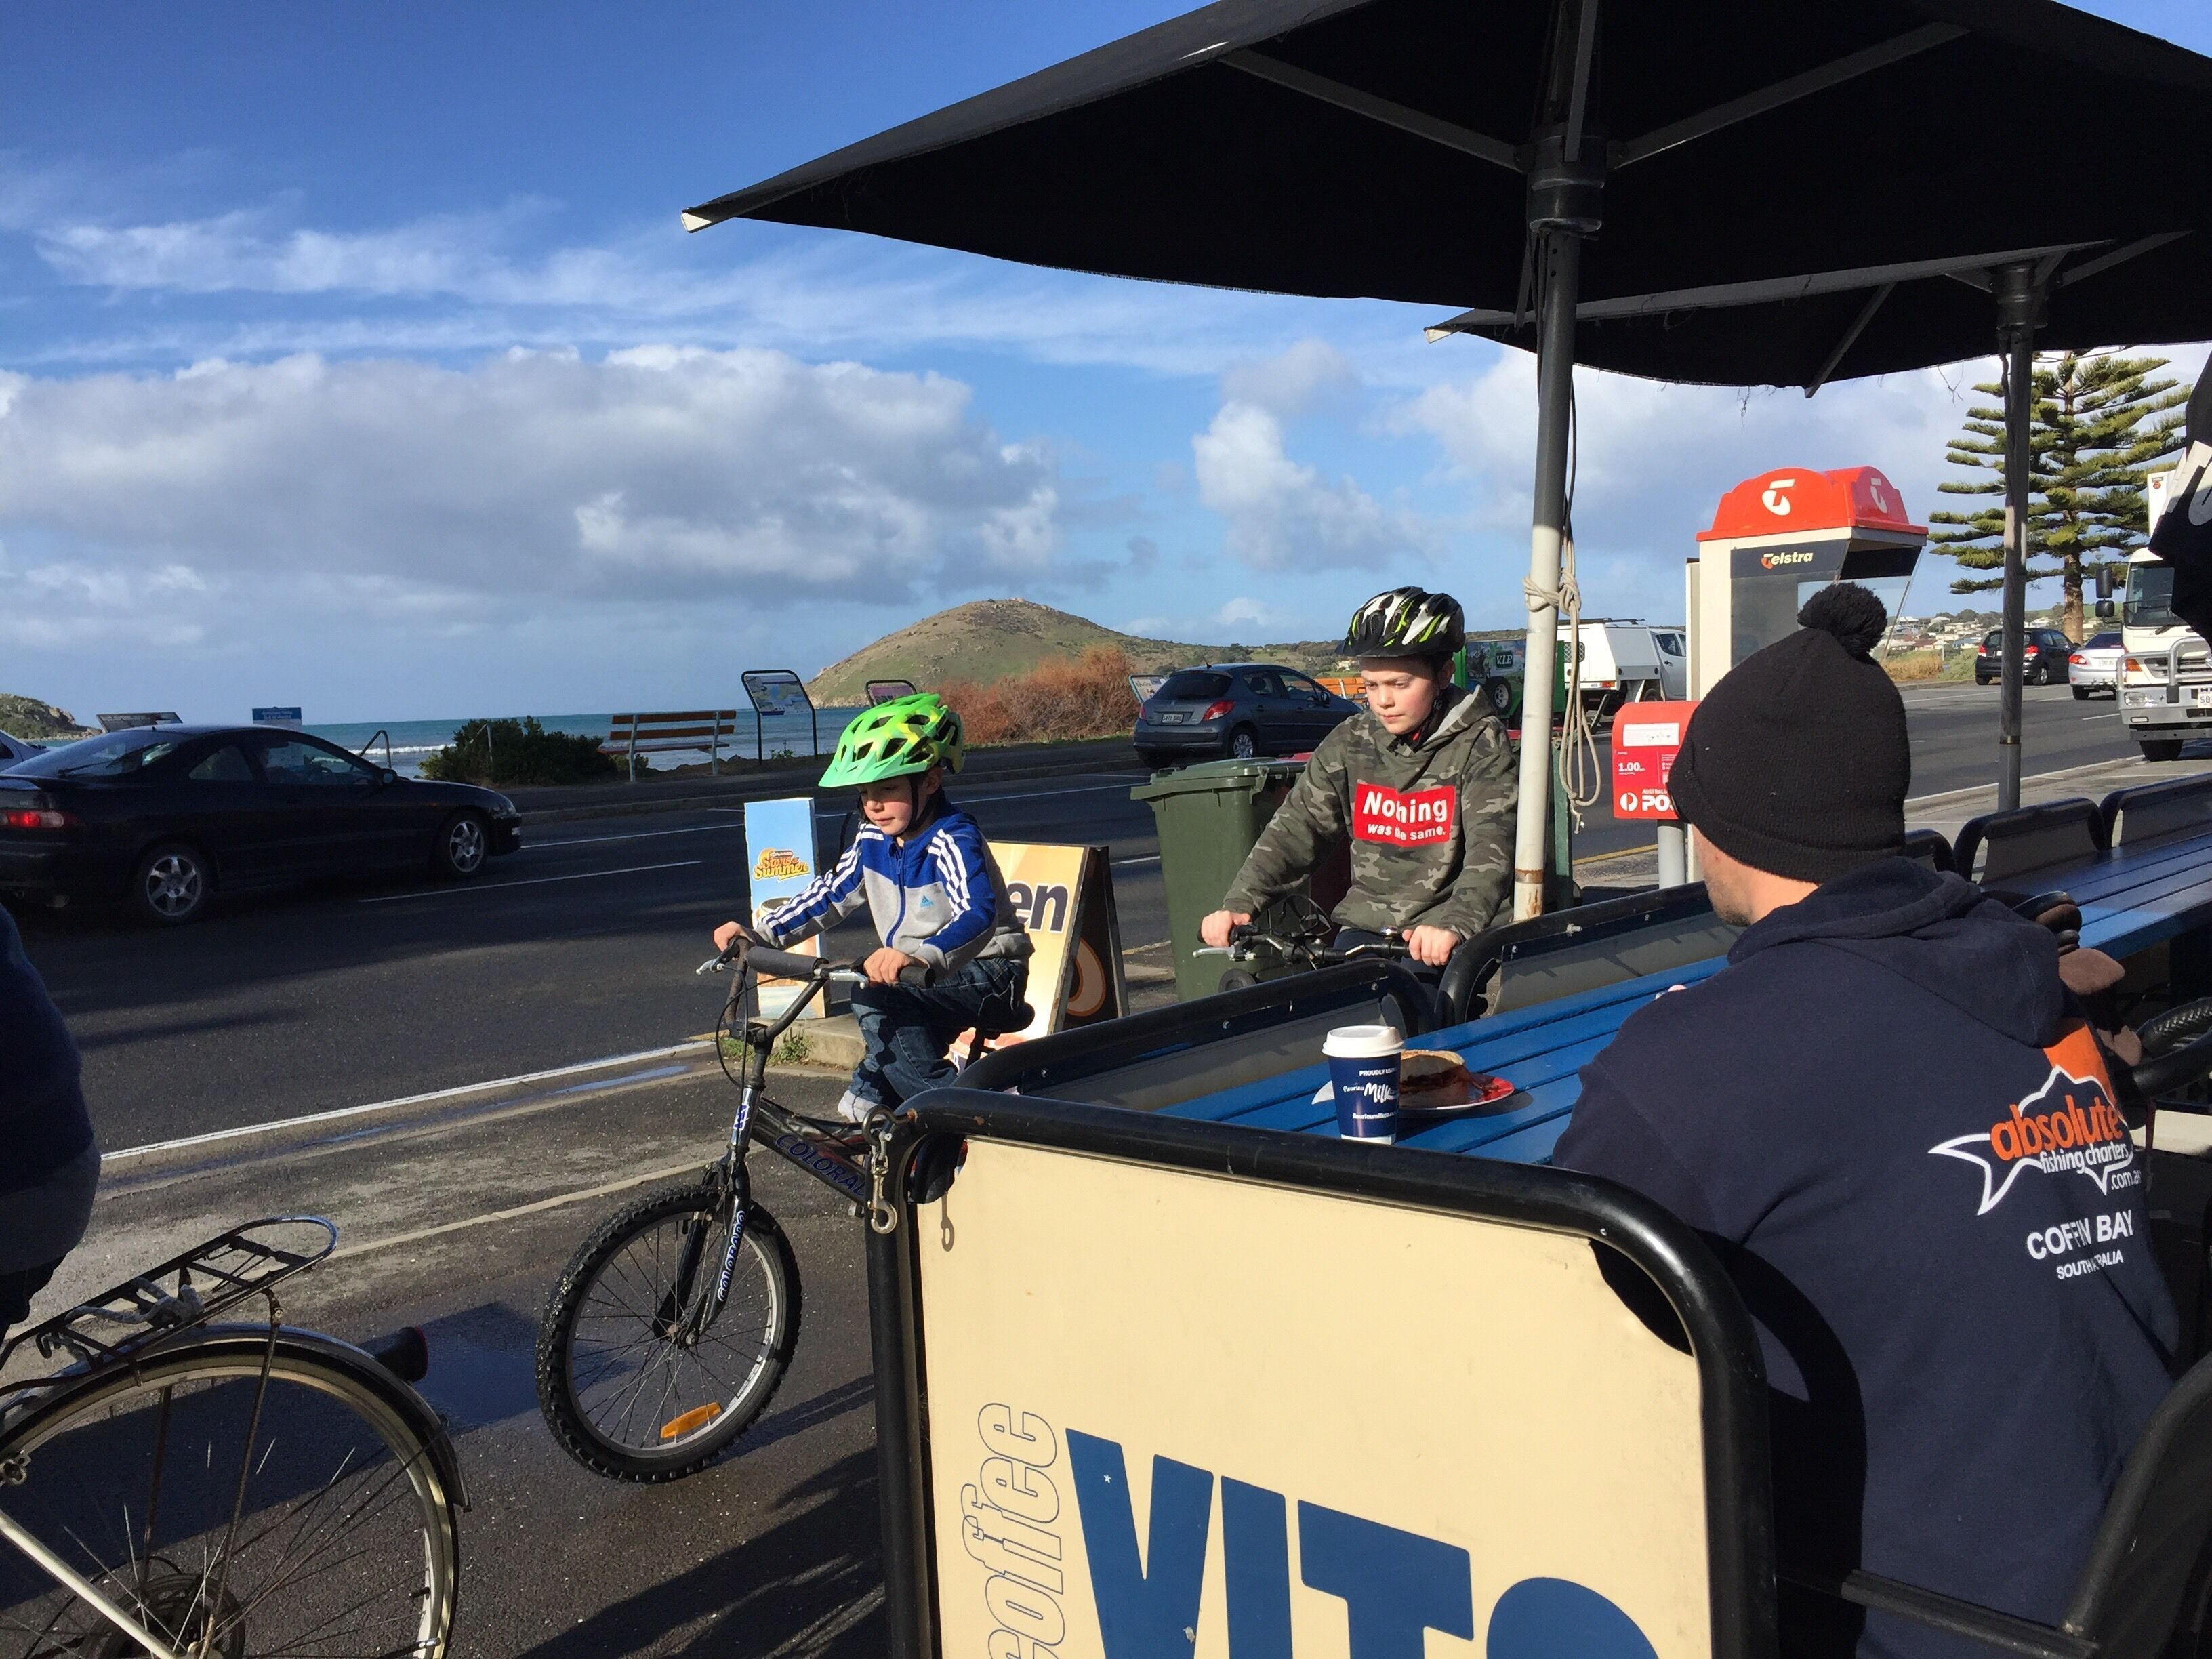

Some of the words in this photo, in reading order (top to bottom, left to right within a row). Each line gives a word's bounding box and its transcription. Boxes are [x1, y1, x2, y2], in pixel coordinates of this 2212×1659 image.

[1761, 552, 1813, 569] Telstra
[1363, 791, 1447, 823] Nohing
[1642, 794, 1674, 811] PO
[1368, 823, 1392, 836] was
[1410, 825, 1446, 840] same.
[754, 861, 809, 880] Summer
[761, 856, 792, 869] Stars
[1364, 1082, 1398, 1103] Milk
[1990, 1094, 2124, 1161] absolute
[2040, 1149, 2086, 1174] fishing
[2085, 1141, 2129, 1167] charters
[2097, 1210, 2134, 1243] BAY
